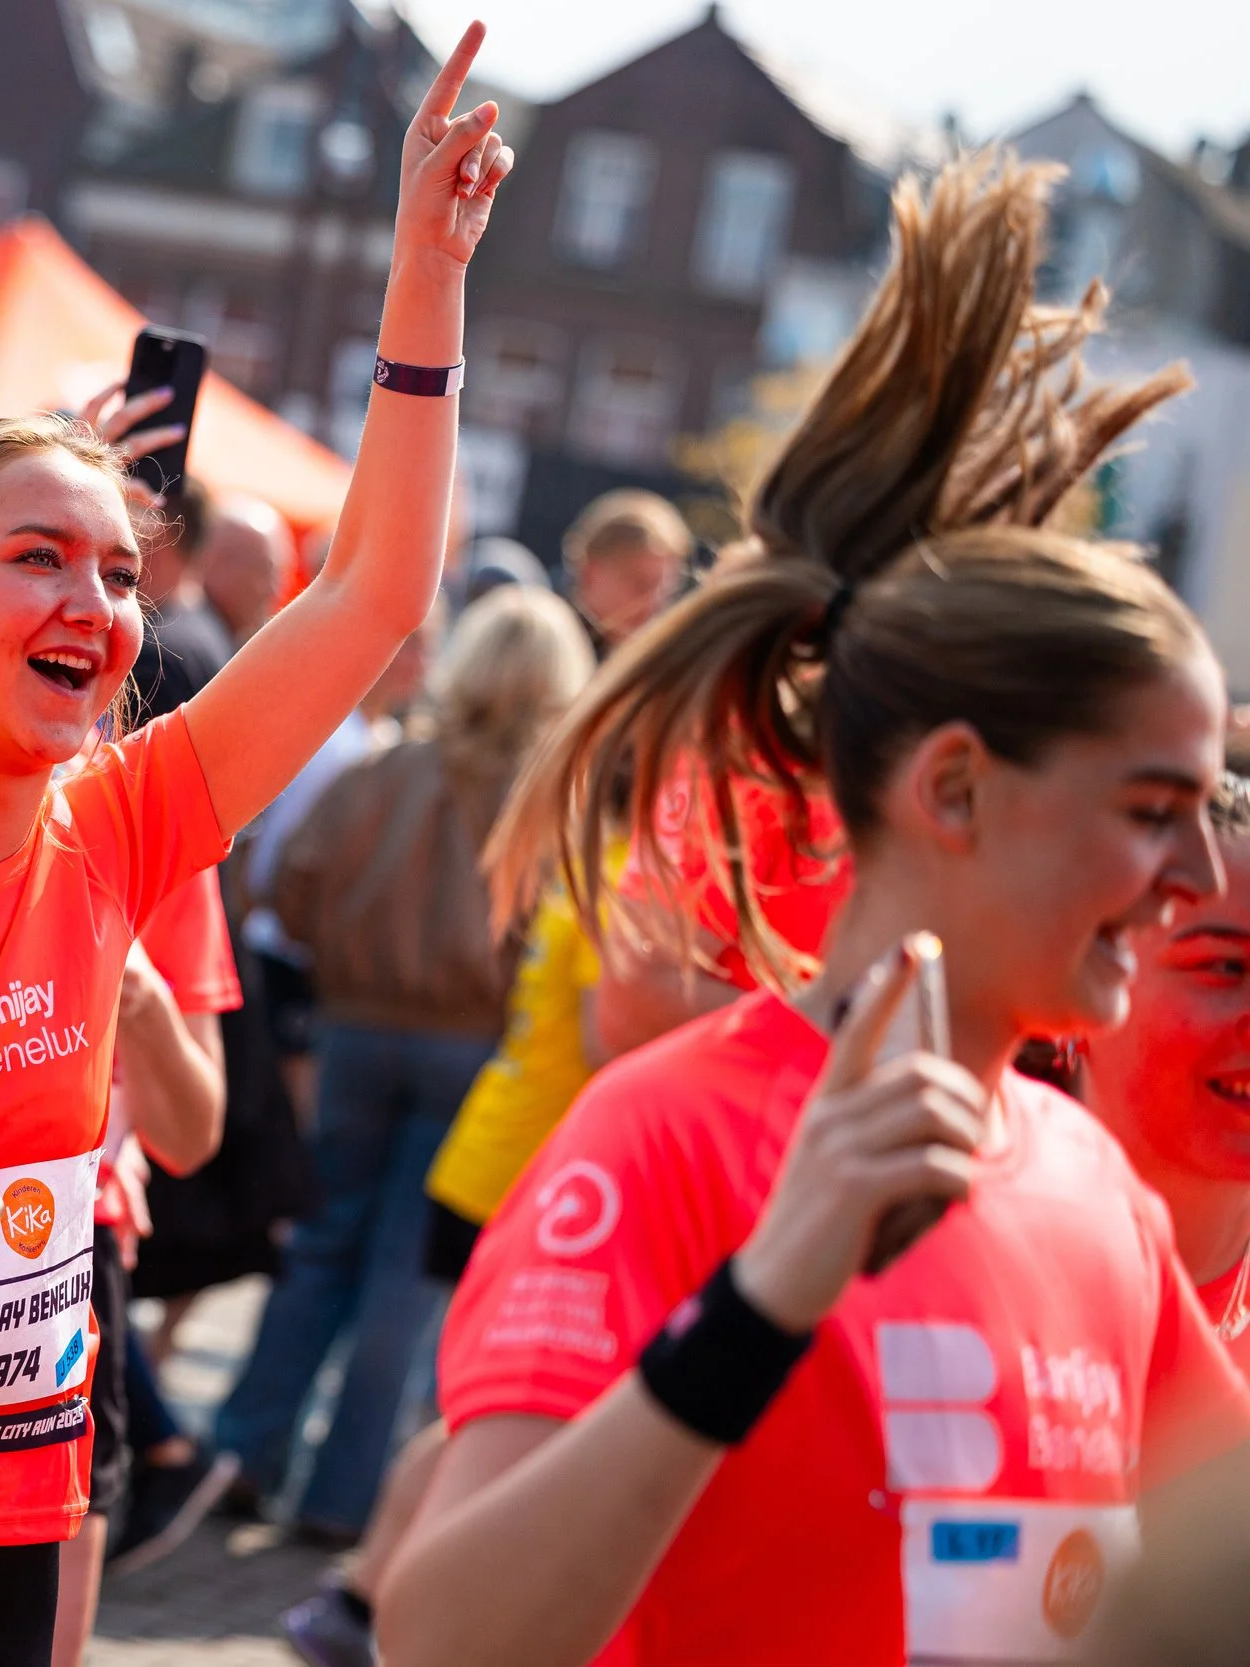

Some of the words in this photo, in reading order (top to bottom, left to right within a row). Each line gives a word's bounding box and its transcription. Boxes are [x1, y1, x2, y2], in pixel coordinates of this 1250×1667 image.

[12, 1185, 41, 1198] Kinderen
[6, 1204, 52, 1239] KiKa
[28, 1270, 91, 1325] BENELUX
[66, 1339, 79, 1367] 538
[0, 1421, 33, 1440] CITY
[31, 1415, 57, 1436] RUN
[56, 1406, 84, 1430] 2025
